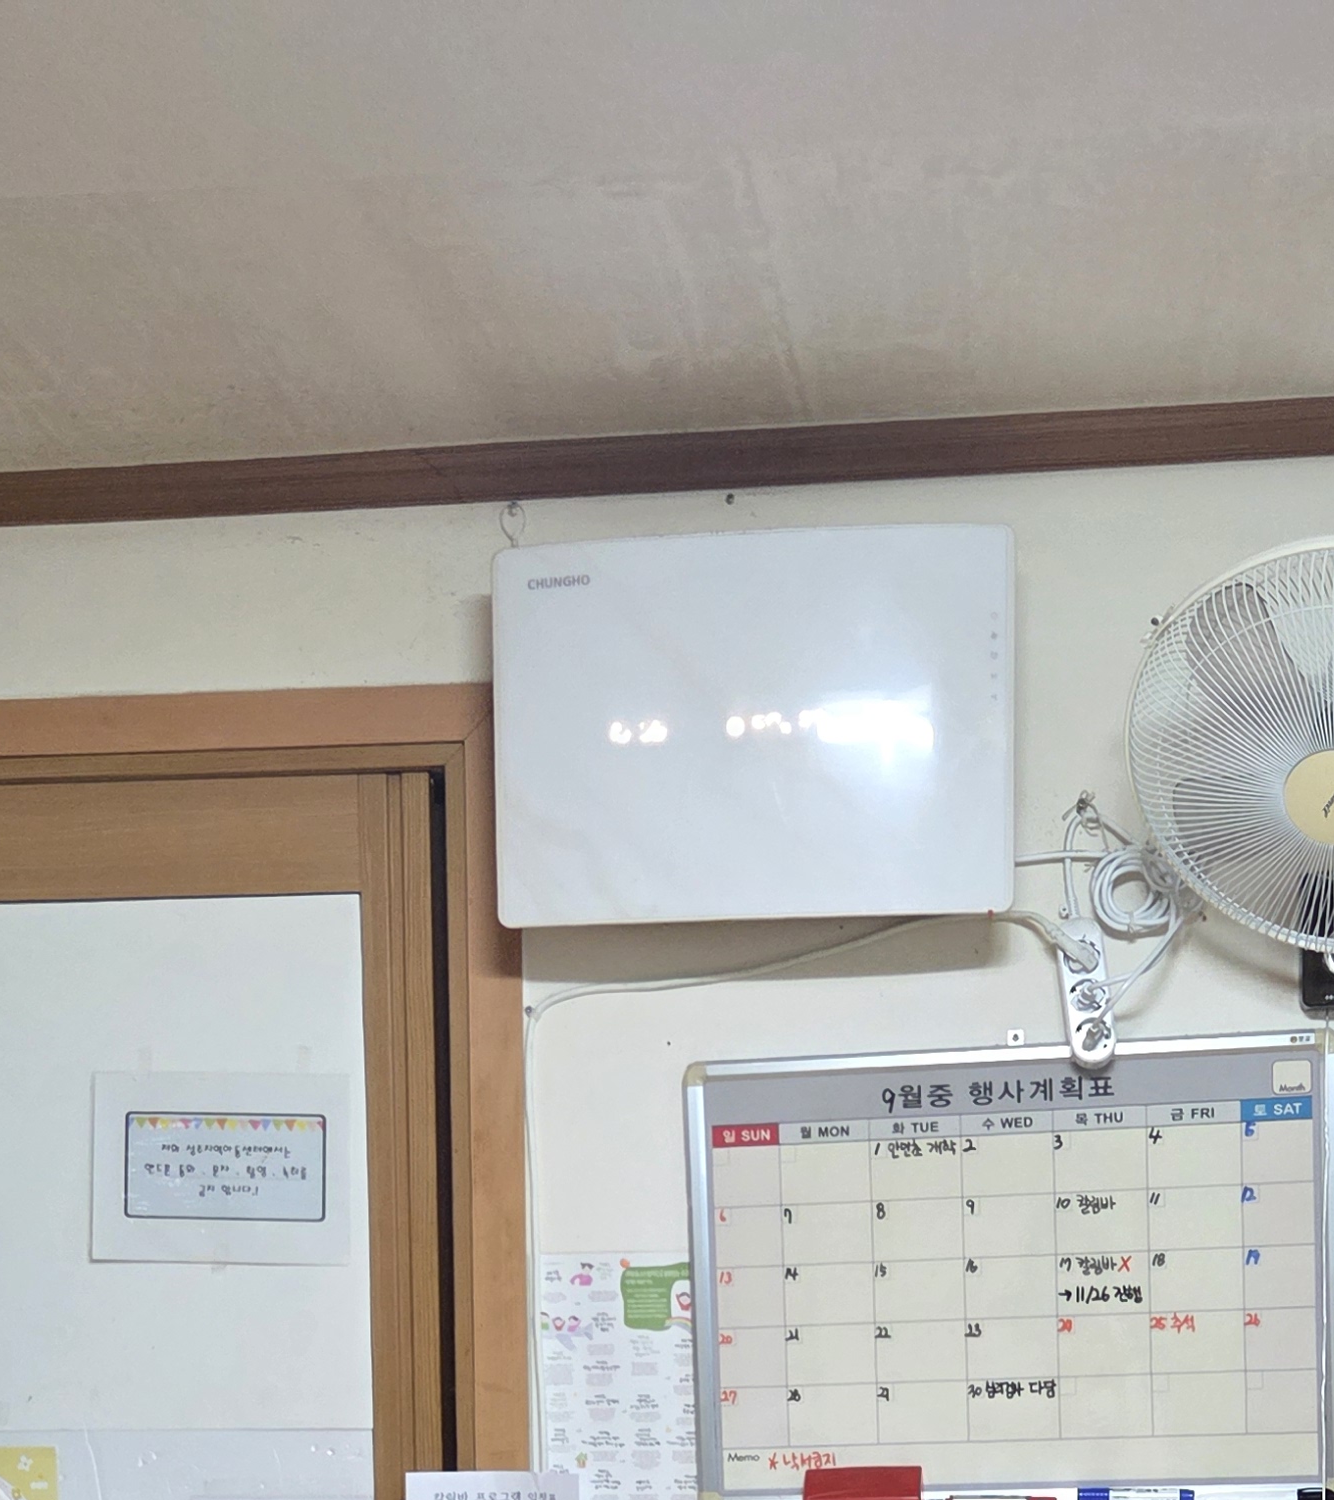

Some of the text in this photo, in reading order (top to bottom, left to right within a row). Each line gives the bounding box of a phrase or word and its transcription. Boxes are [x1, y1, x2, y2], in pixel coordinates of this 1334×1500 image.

[527, 575, 590, 590] CHUNGHO
[968, 1076, 1115, 1106] 행사계획표
[1278, 1082, 1306, 1093] Month
[1170, 1107, 1215, 1120] 금 FRI
[1273, 1102, 1303, 1115] SAT
[982, 1116, 1033, 1131] 수 WED
[1075, 1112, 1124, 1125] 목 THU
[800, 1125, 850, 1139] 월 MON
[892, 1121, 939, 1134] 화 TUE
[722, 1129, 771, 1144] 일 SUN
[1052, 1134, 1063, 1150] 3
[1148, 1127, 1163, 1144] 4
[962, 1138, 977, 1152] 2
[1055, 1194, 1116, 1215] 10 칼림바
[1149, 1192, 1161, 1205] 11
[876, 1202, 886, 1220] 8
[965, 1199, 975, 1215] 9
[719, 1208, 727, 1222] 6
[784, 1208, 793, 1224] 7
[965, 1258, 978, 1274] 16
[1075, 1255, 1117, 1276] 칼림바
[1152, 1253, 1165, 1267] 18
[719, 1270, 733, 1284] 13
[784, 1267, 799, 1281] 14
[874, 1263, 887, 1277] 15
[1076, 1285, 1110, 1305] 11/26
[1150, 1316, 1167, 1330] 25
[1243, 1312, 1261, 1327] 26
[784, 1328, 800, 1341] 21
[874, 1326, 891, 1339] 22
[964, 1323, 981, 1337] 23
[719, 1333, 733, 1344] 20
[720, 1390, 736, 1404] 27
[787, 1389, 801, 1402] 28
[967, 1384, 982, 1398] 30
[727, 1452, 760, 1462] Memo
